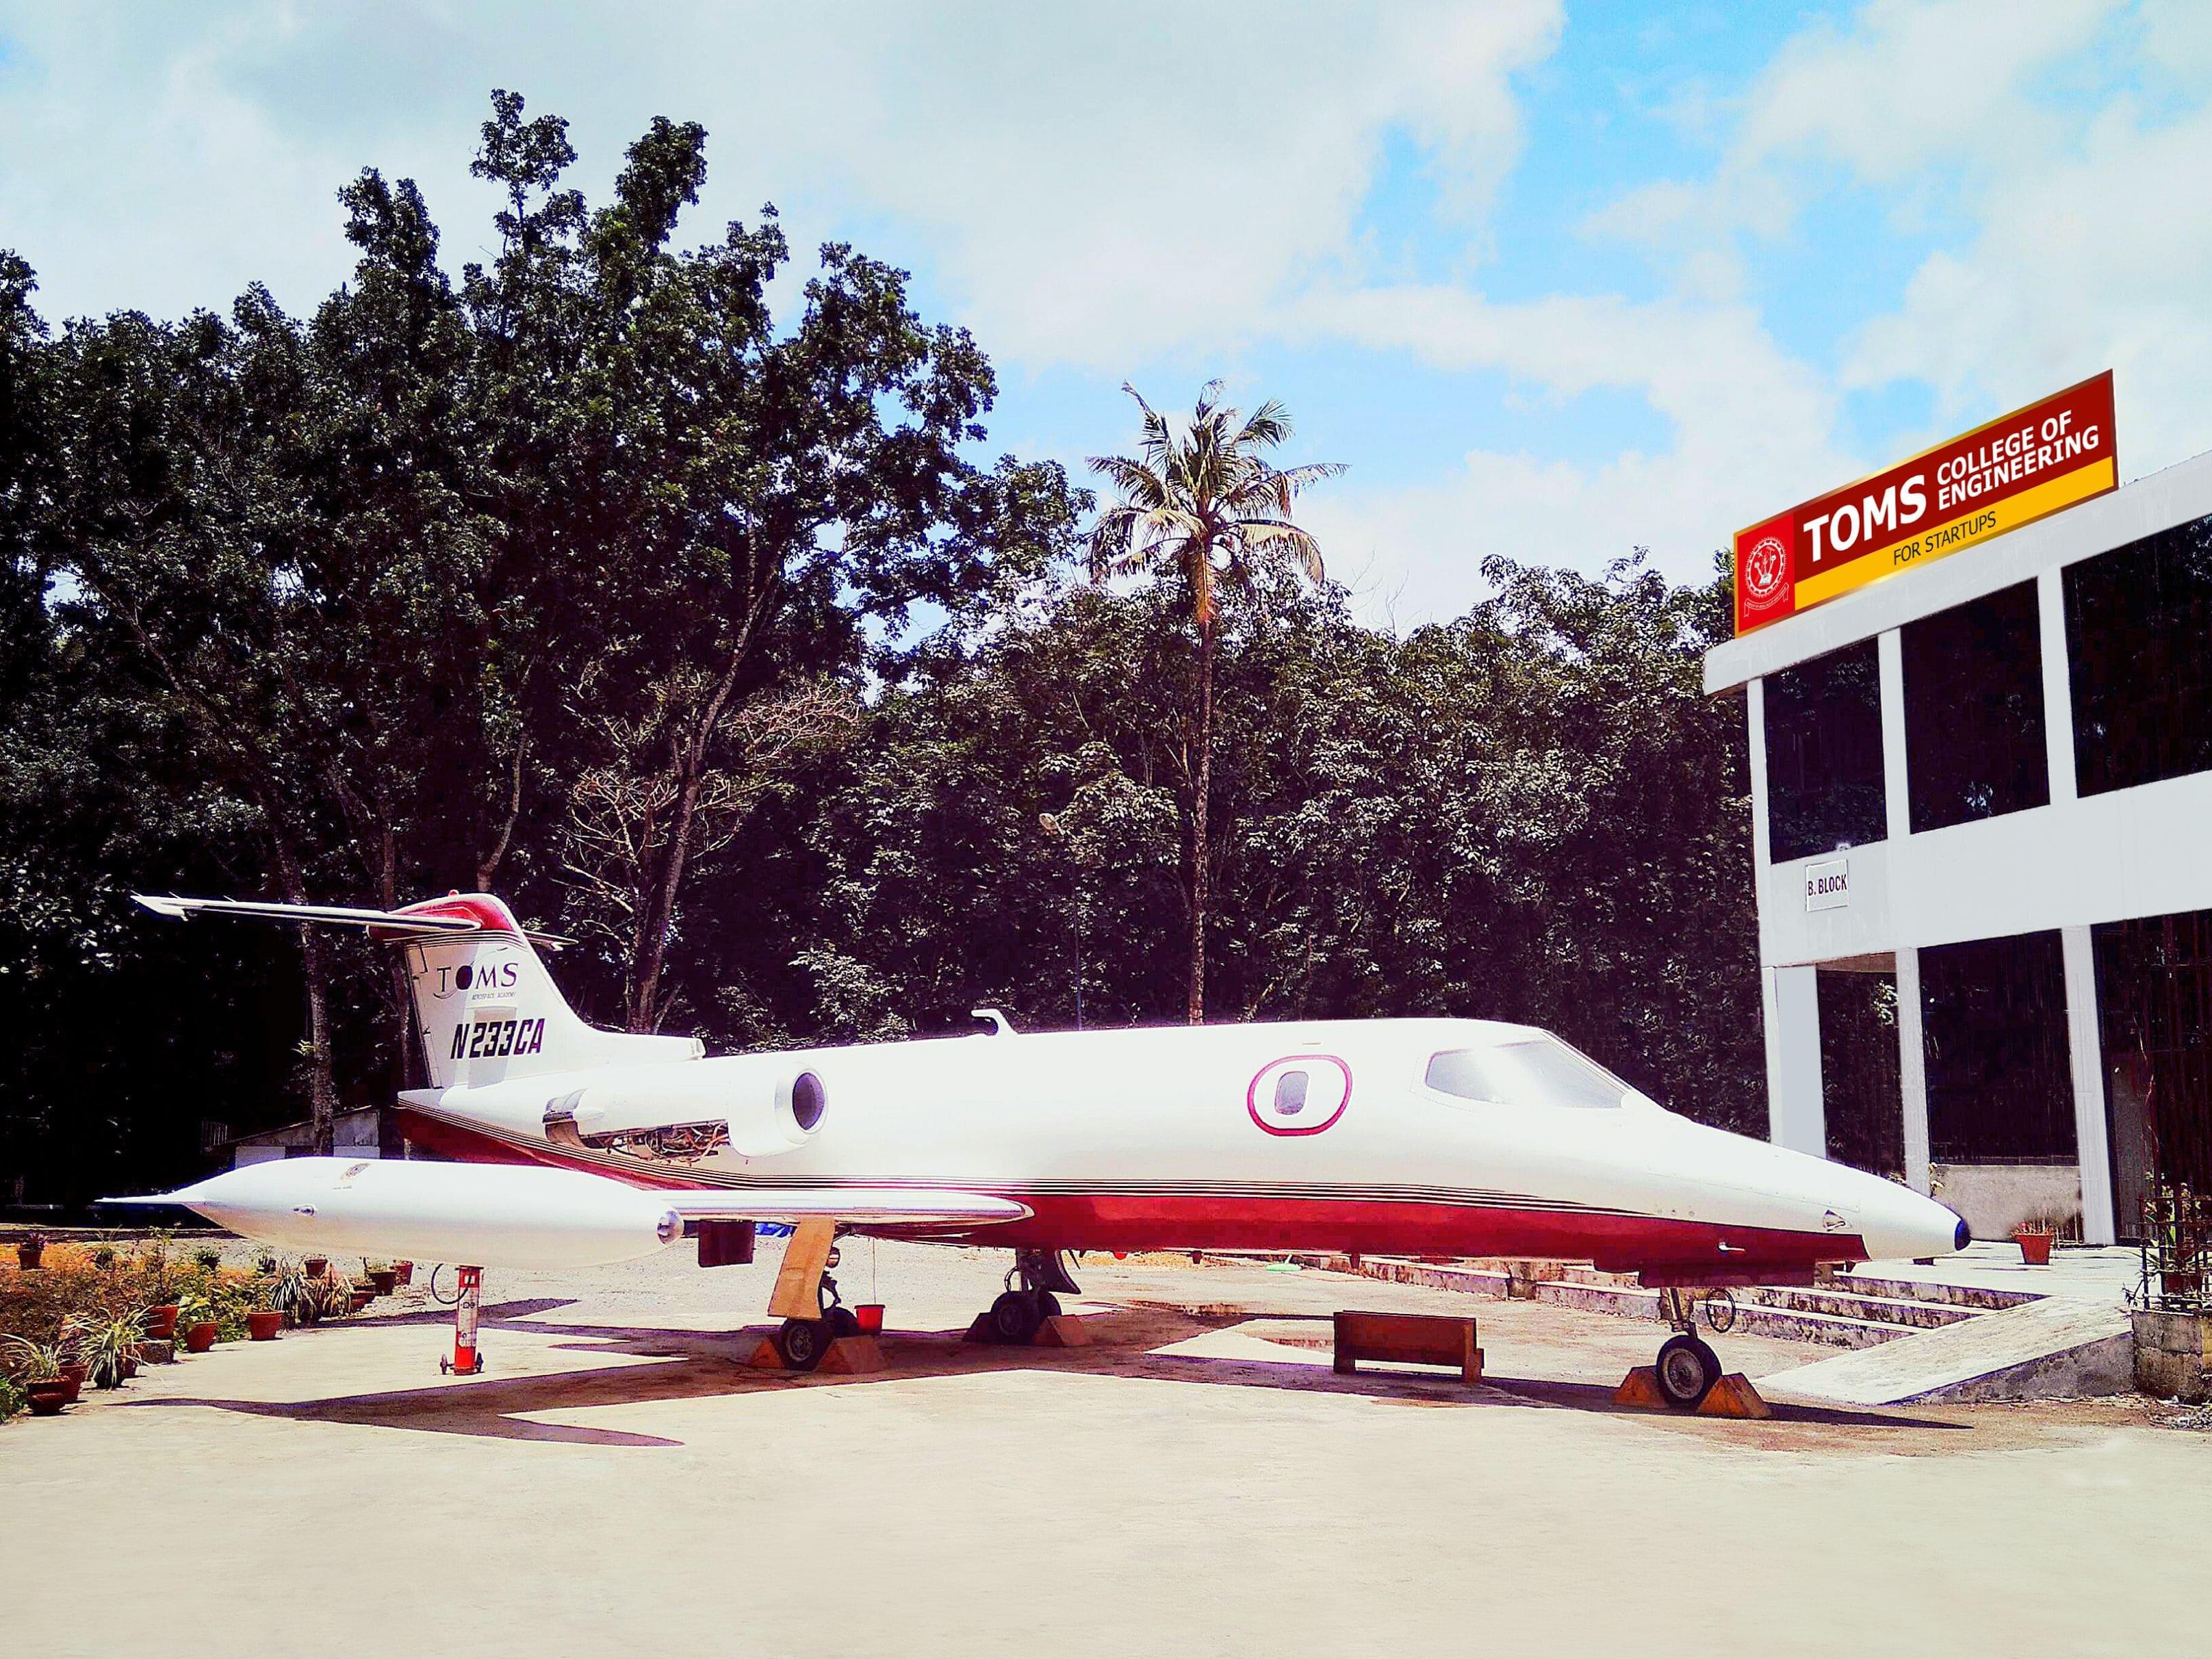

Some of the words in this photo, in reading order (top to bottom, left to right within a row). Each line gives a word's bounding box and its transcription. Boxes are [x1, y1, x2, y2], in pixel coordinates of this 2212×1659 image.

[1936, 425, 2035, 485] COLLEGE
[2041, 410, 2073, 442] OF
[1938, 425, 2099, 511] ENGINEERING
[1803, 474, 1927, 562] TOMS
[1893, 541, 1922, 566] FOR
[1925, 511, 1997, 552] STARTUPS
[1818, 874, 1847, 894] BLOCK
[437, 962, 519, 992] TOMS
[450, 1018, 545, 1059] N233CA
